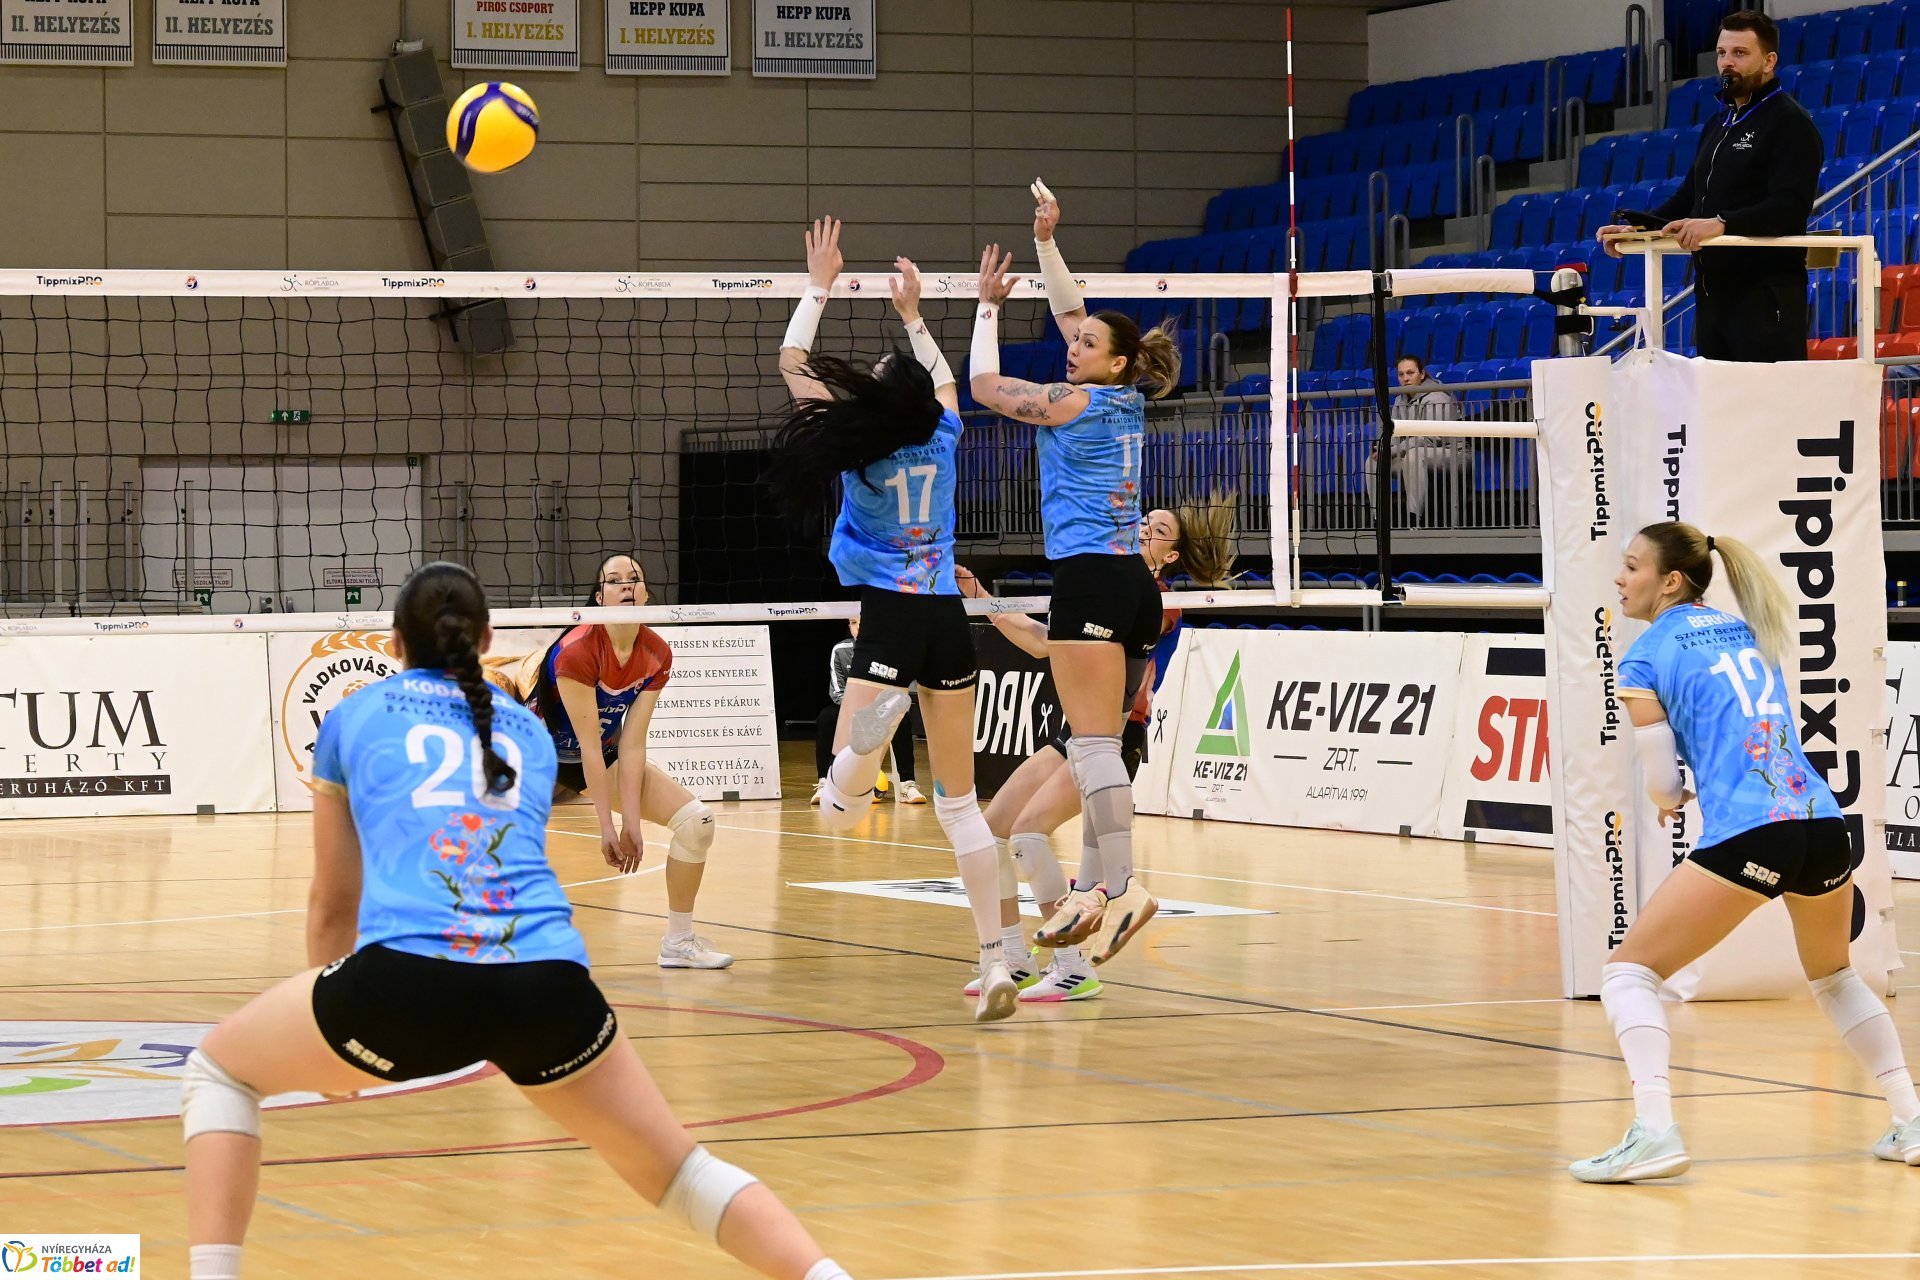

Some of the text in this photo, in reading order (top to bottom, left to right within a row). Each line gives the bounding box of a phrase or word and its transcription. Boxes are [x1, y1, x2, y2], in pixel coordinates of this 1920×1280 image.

[477, 1, 554, 13] PIROS CSOPORT
[629, 2, 705, 16] HEPP KUPA
[777, 6, 851, 20] HEPP KUPA
[11, 11, 120, 34] II. HELYEZÉS
[165, 13, 273, 35] II. HELYEZÉS
[467, 19, 564, 40] I. HELYEZÉS
[620, 24, 715, 45] I. HELYEZÉS
[764, 28, 863, 49] II. HELYEZÉS
[36, 275, 102, 287] TippmixPRO
[382, 278, 445, 289] TippmixPRO
[712, 279, 772, 290] TippmixPRO
[1585, 401, 1611, 541] TippmixPRO
[884, 464, 938, 524] 17
[767, 607, 818, 616] TippmixPRO
[94, 621, 149, 632] TippmixPRO
[712, 636, 756, 648] KÉSZÜLT
[705, 669, 758, 678] KENYEREK
[1594, 607, 1618, 746] TippmixPRO
[1709, 648, 1785, 718] 12
[654, 695, 761, 708] ÉKMENTES PÉKÁRUK
[1266, 680, 1436, 736] KE-VIZ 21
[649, 725, 763, 738] SZENDVICSEK ÉS KÁVÉ
[405, 723, 523, 812] 20
[668, 758, 764, 771] NYÍREGYHÁZA,
[1323, 747, 1360, 772] ZRT.
[732, 773, 749, 785] ÚT
[753, 776, 765, 785] 21
[1193, 760, 1248, 781] KE-VIZ 21
[124, 778, 165, 792] KFT
[1306, 784, 1368, 801] ALAPÍTVA 1991
[1604, 811, 1628, 950] TippmixPRO
[1742, 861, 1781, 885] SDG
